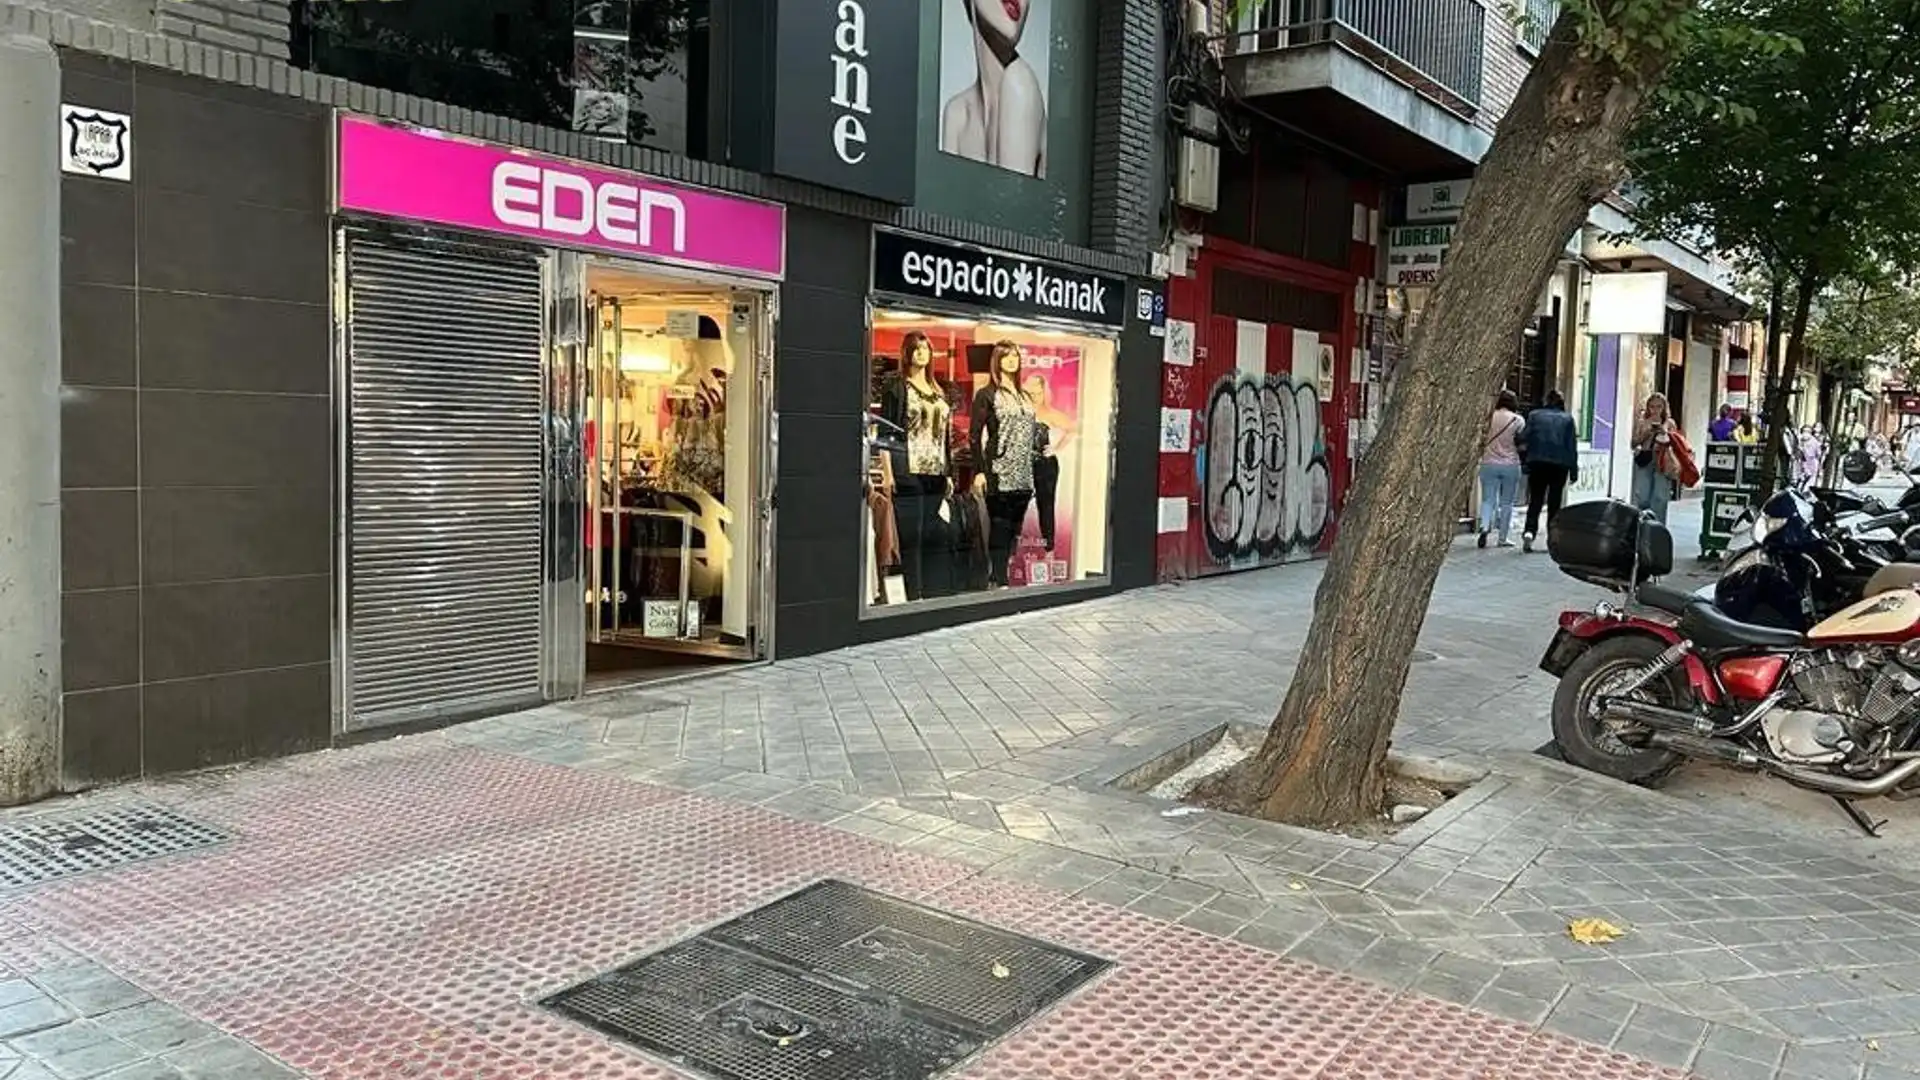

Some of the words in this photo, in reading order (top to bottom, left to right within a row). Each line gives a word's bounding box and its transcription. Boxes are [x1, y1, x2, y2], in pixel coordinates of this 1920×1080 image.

[830, 0, 871, 164] ane
[492, 161, 686, 252] EDEN
[902, 250, 1010, 297] espacio
[1035, 266, 1106, 314] kanak
